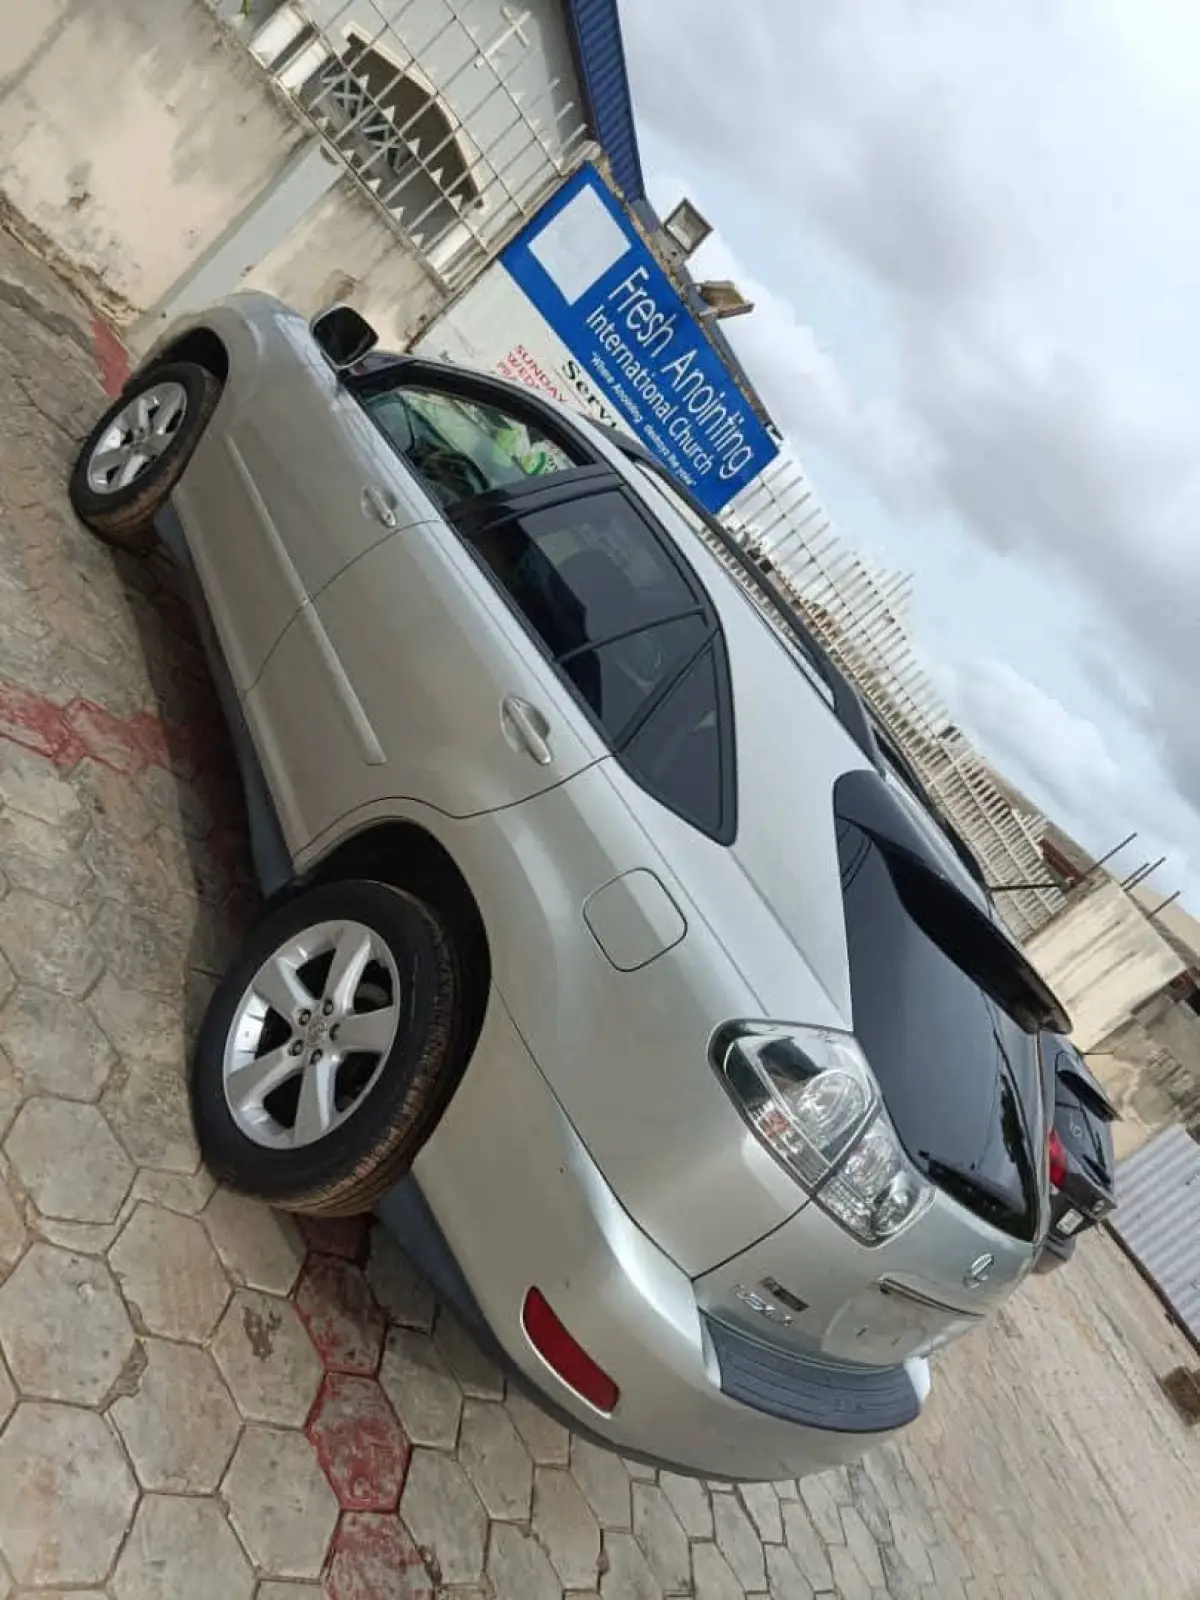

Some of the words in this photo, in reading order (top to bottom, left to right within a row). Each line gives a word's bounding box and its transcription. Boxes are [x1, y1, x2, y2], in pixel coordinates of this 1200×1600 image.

[515, 344, 571, 402] SUNDAY
[586, 304, 676, 424] International
[669, 417, 714, 475] Church
[608, 265, 674, 358] Fresh
[661, 349, 755, 480] Anointing
